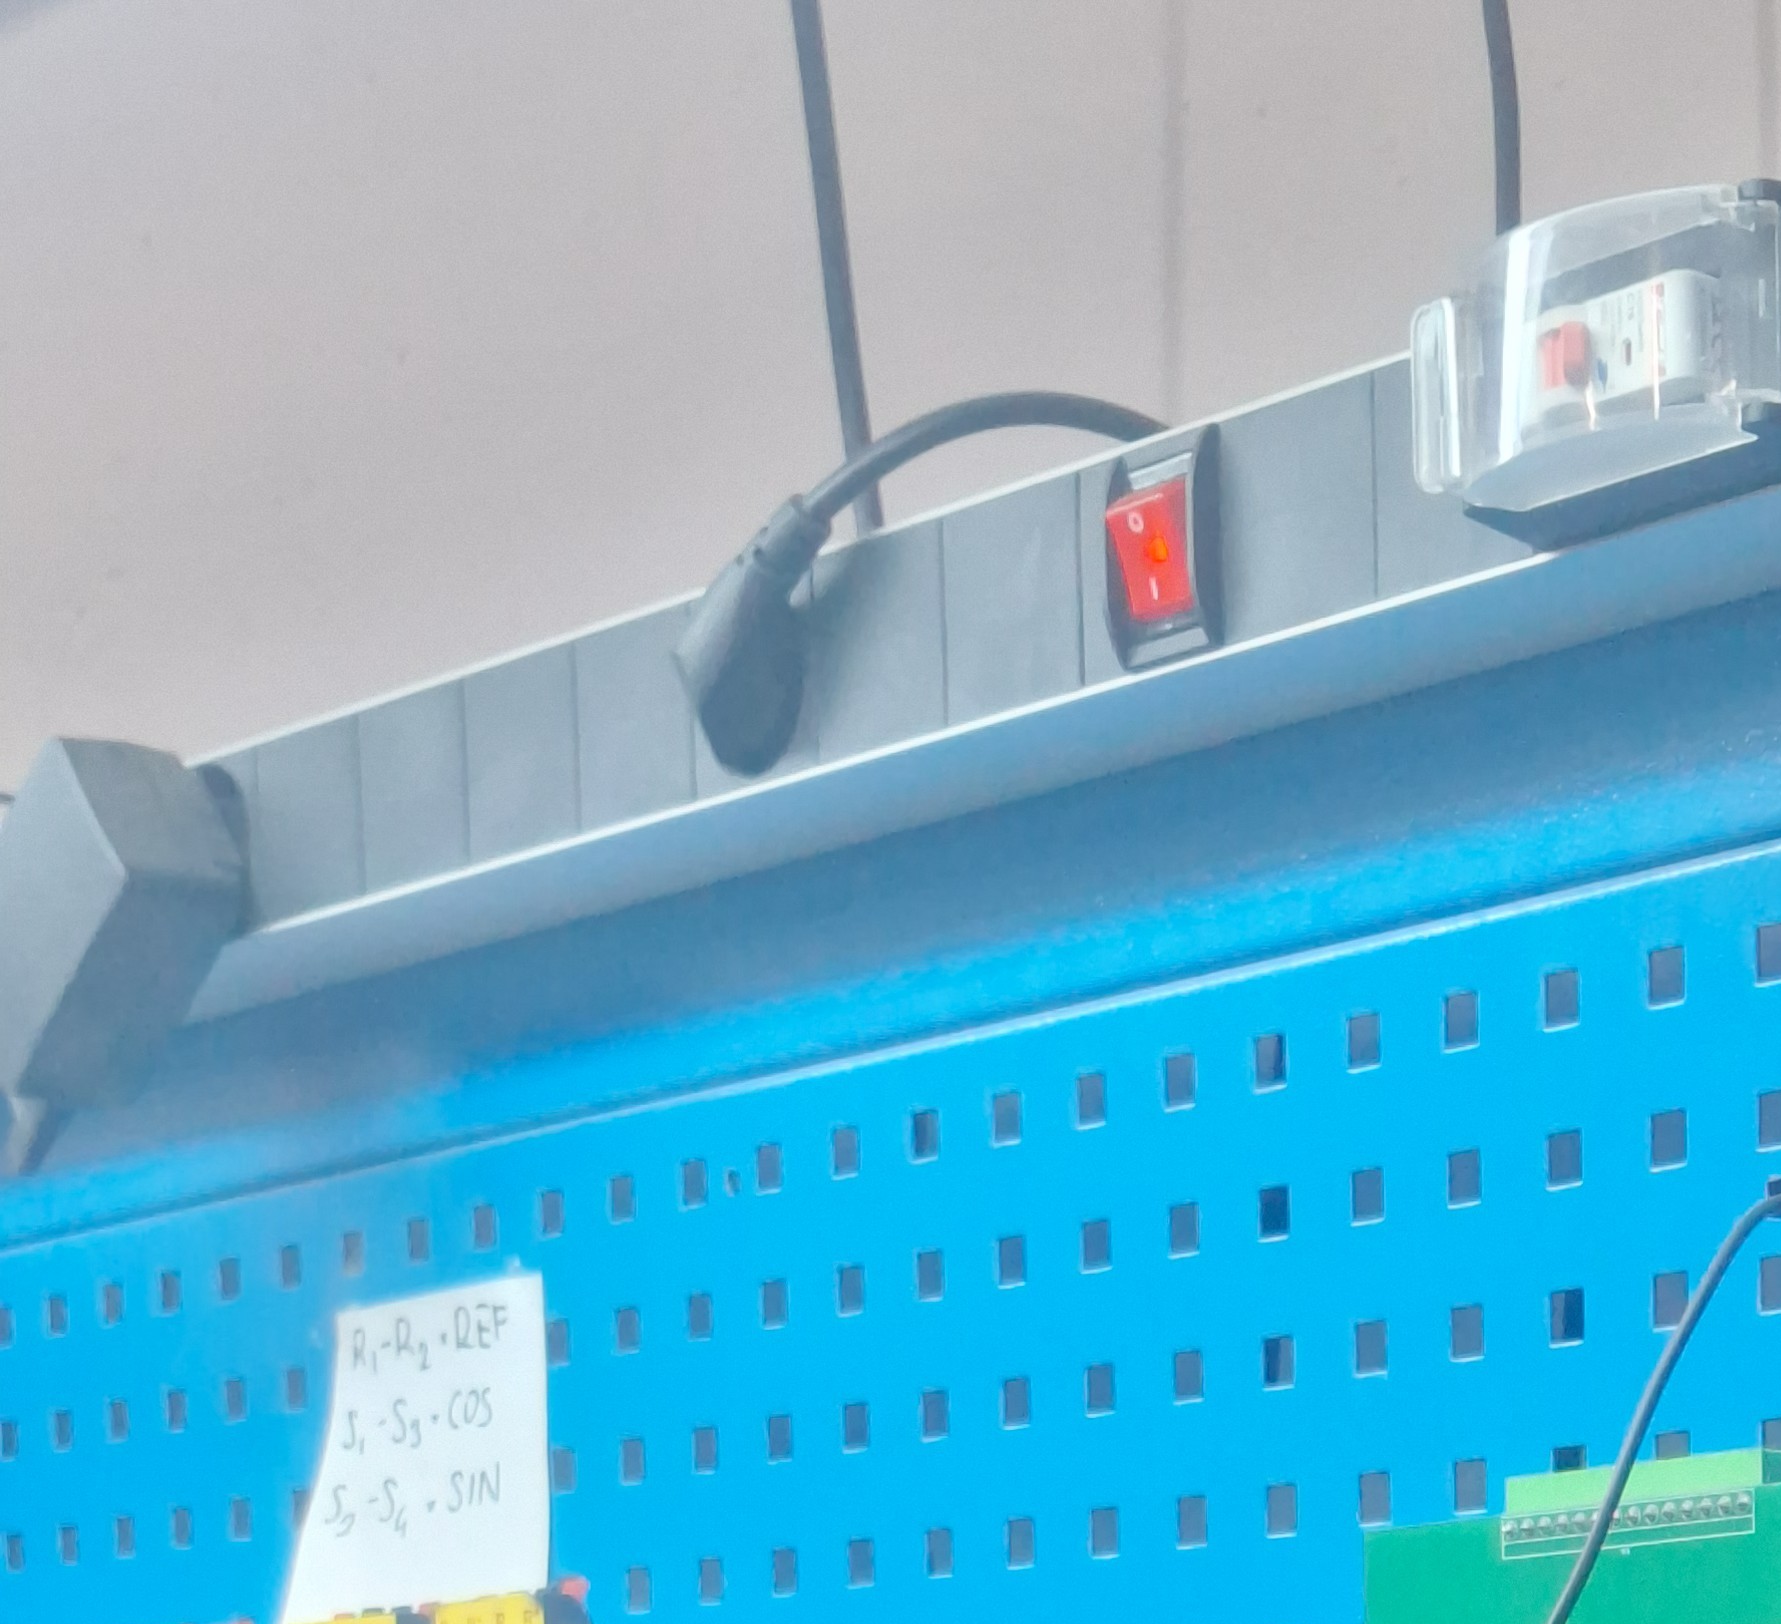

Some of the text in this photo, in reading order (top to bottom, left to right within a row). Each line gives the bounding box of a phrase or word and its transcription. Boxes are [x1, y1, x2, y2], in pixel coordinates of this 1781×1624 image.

[453, 1302, 509, 1351] REF
[447, 1386, 494, 1431] COS
[447, 1460, 501, 1514] SIN
